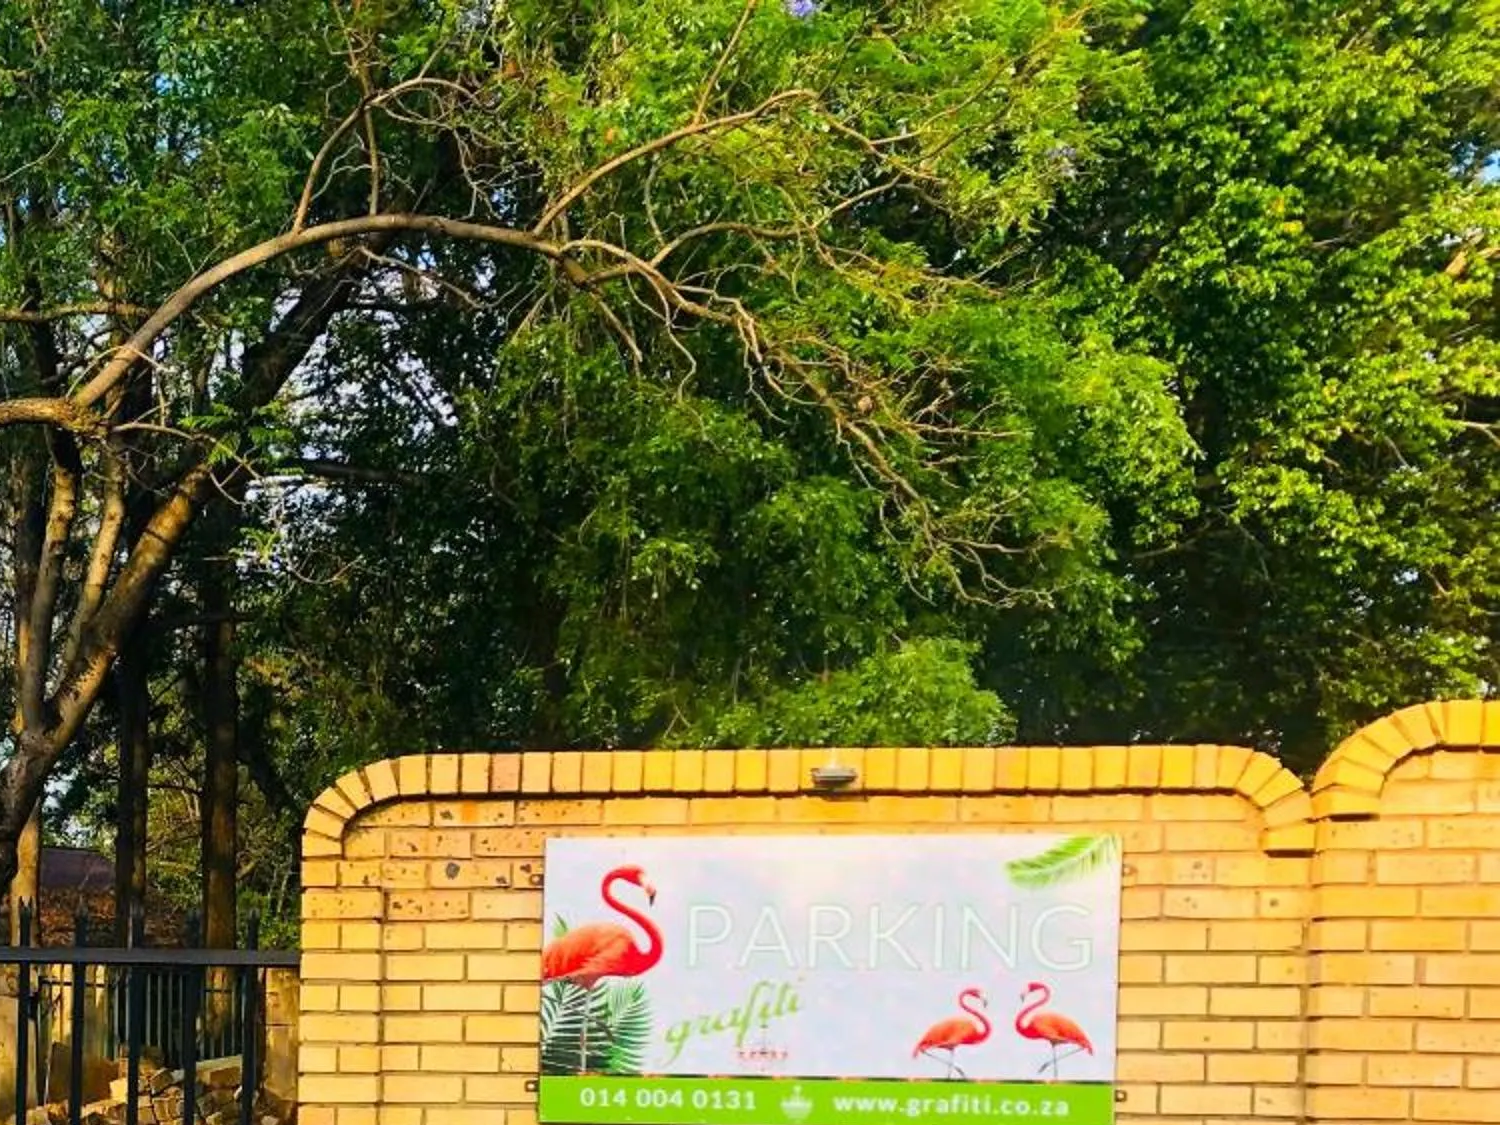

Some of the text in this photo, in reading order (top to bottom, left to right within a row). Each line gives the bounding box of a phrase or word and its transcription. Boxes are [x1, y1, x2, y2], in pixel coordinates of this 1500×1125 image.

[685, 902, 1096, 972] PARKING
[656, 976, 804, 1067] grafiti
[579, 1087, 756, 1111] 014 004 0131
[833, 1094, 1070, 1117] www.grafiti.co.za
